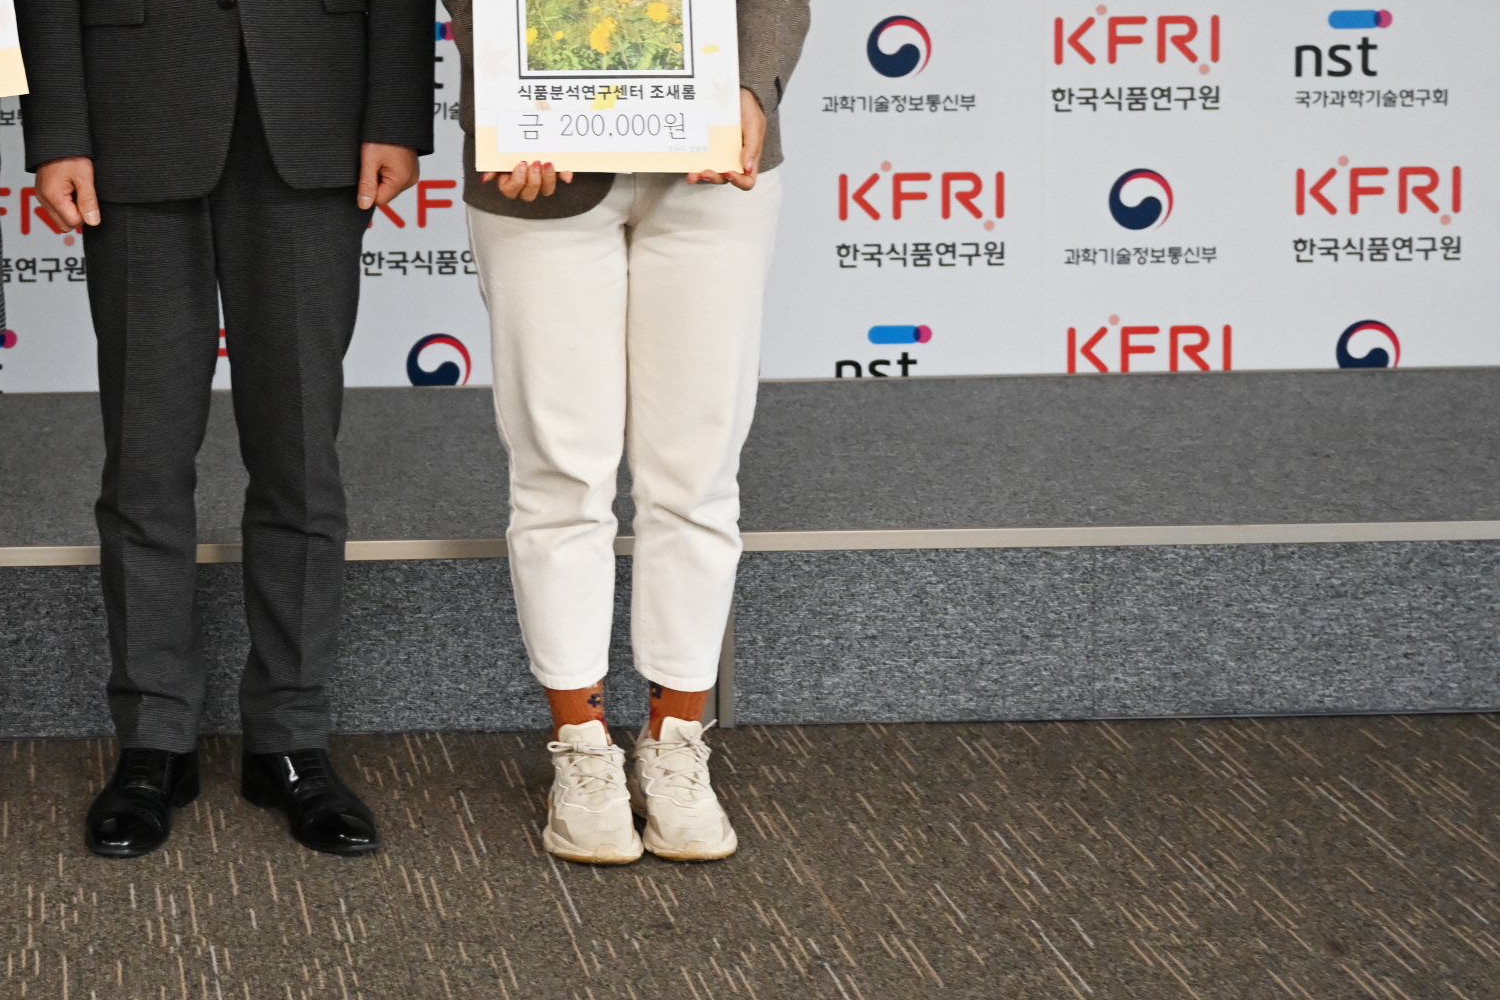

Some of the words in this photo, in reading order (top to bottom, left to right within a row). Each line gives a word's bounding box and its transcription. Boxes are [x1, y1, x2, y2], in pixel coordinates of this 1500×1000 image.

[1055, 16, 1219, 64] KFRI
[1295, 37, 1377, 77] nst
[517, 84, 644, 100] 식품분석연구센터
[650, 84, 696, 100] 조새롬
[822, 95, 975, 113] 과학기술정보통신부
[1052, 86, 1219, 112] 한국식품연구원
[1295, 89, 1448, 108] 국가과학기술연구회
[518, 114, 544, 140] 금
[840, 172, 1004, 220] KFRI
[1297, 167, 1460, 214] KFRI
[836, 242, 1004, 268] 한국식품연구원
[1064, 247, 1216, 265] 과학기술정보통신부
[1293, 236, 1461, 263] 한국식품연구원
[1068, 325, 1231, 373] KFRI
